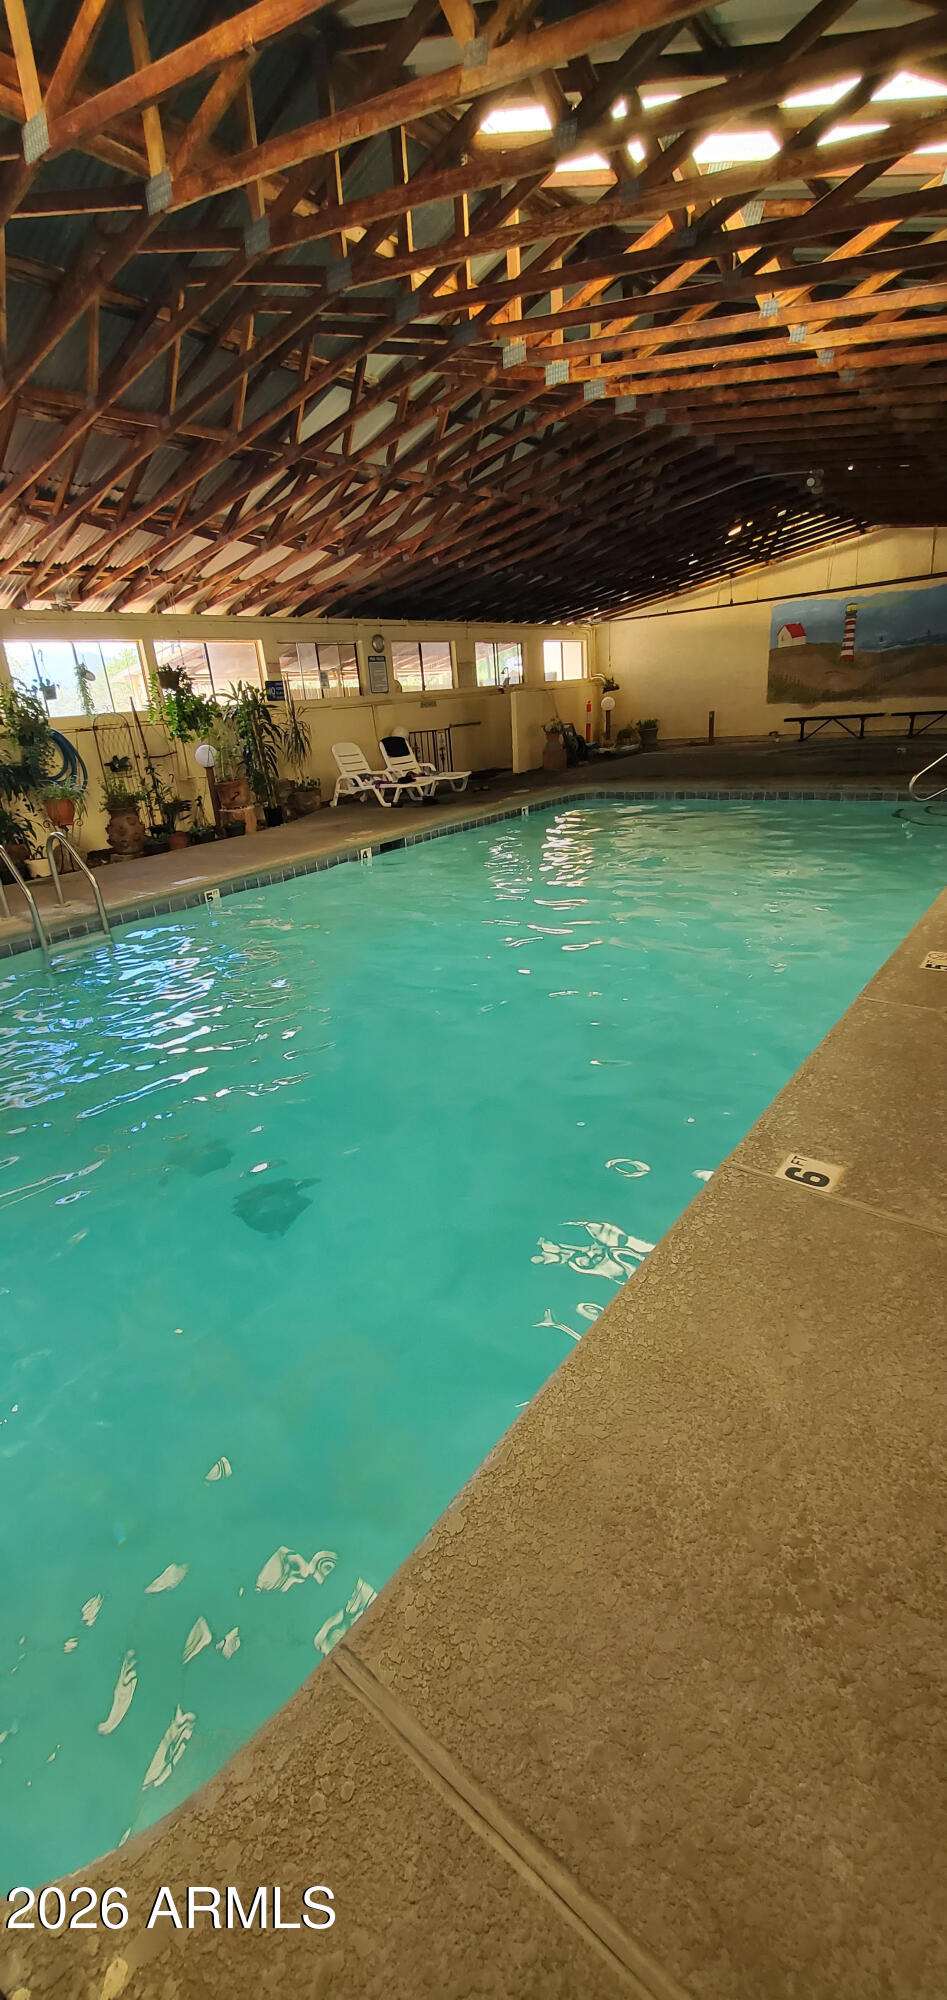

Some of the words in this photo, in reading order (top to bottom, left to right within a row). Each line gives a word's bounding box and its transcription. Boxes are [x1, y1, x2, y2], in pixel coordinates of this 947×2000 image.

[363, 851, 368, 859] 4
[206, 893, 213, 902] 5
[790, 1155, 808, 1167] FT
[784, 1167, 830, 1187] 6
